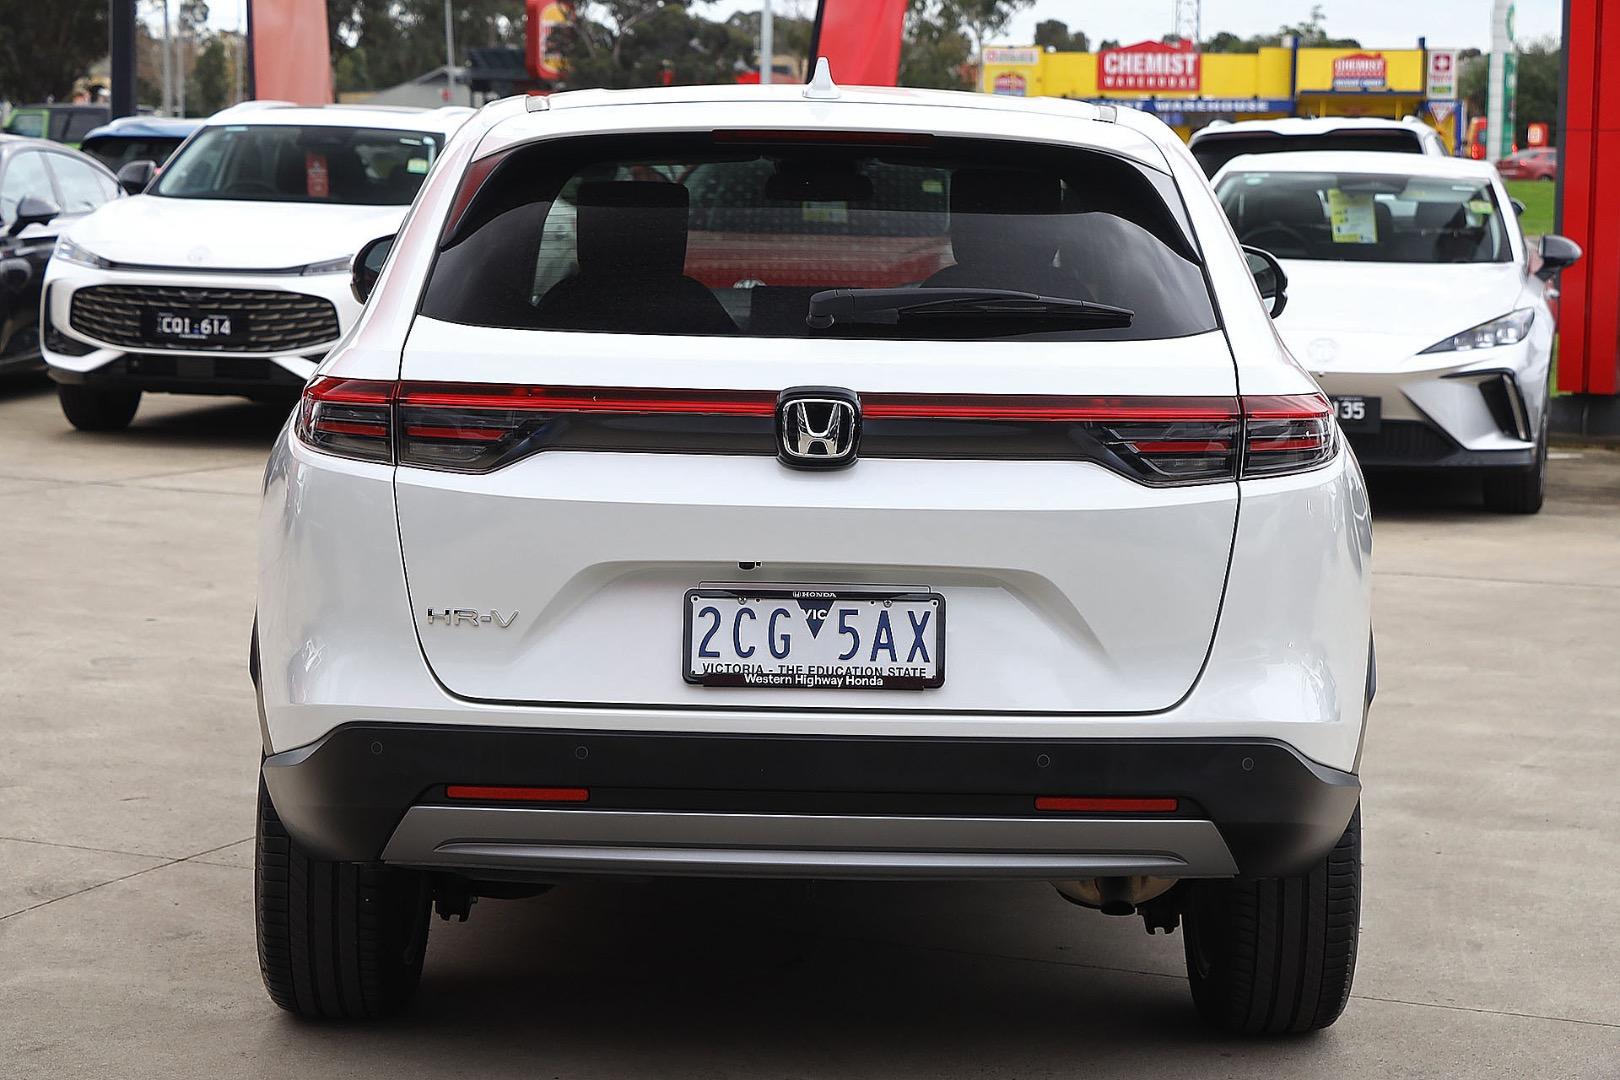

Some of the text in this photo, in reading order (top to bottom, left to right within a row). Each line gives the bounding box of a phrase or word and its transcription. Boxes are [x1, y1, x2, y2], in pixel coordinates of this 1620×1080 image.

[1104, 53, 1196, 75] CHEMIST
[427, 608, 520, 628] HR-V
[801, 609, 828, 620] VIC
[698, 606, 931, 663] 2CG 5AX
[702, 663, 764, 674] VICTORIA
[778, 665, 803, 674] THE
[808, 666, 882, 676] EDUCATION
[888, 667, 926, 677] STATE
[744, 674, 884, 688] Western Highway Honda
